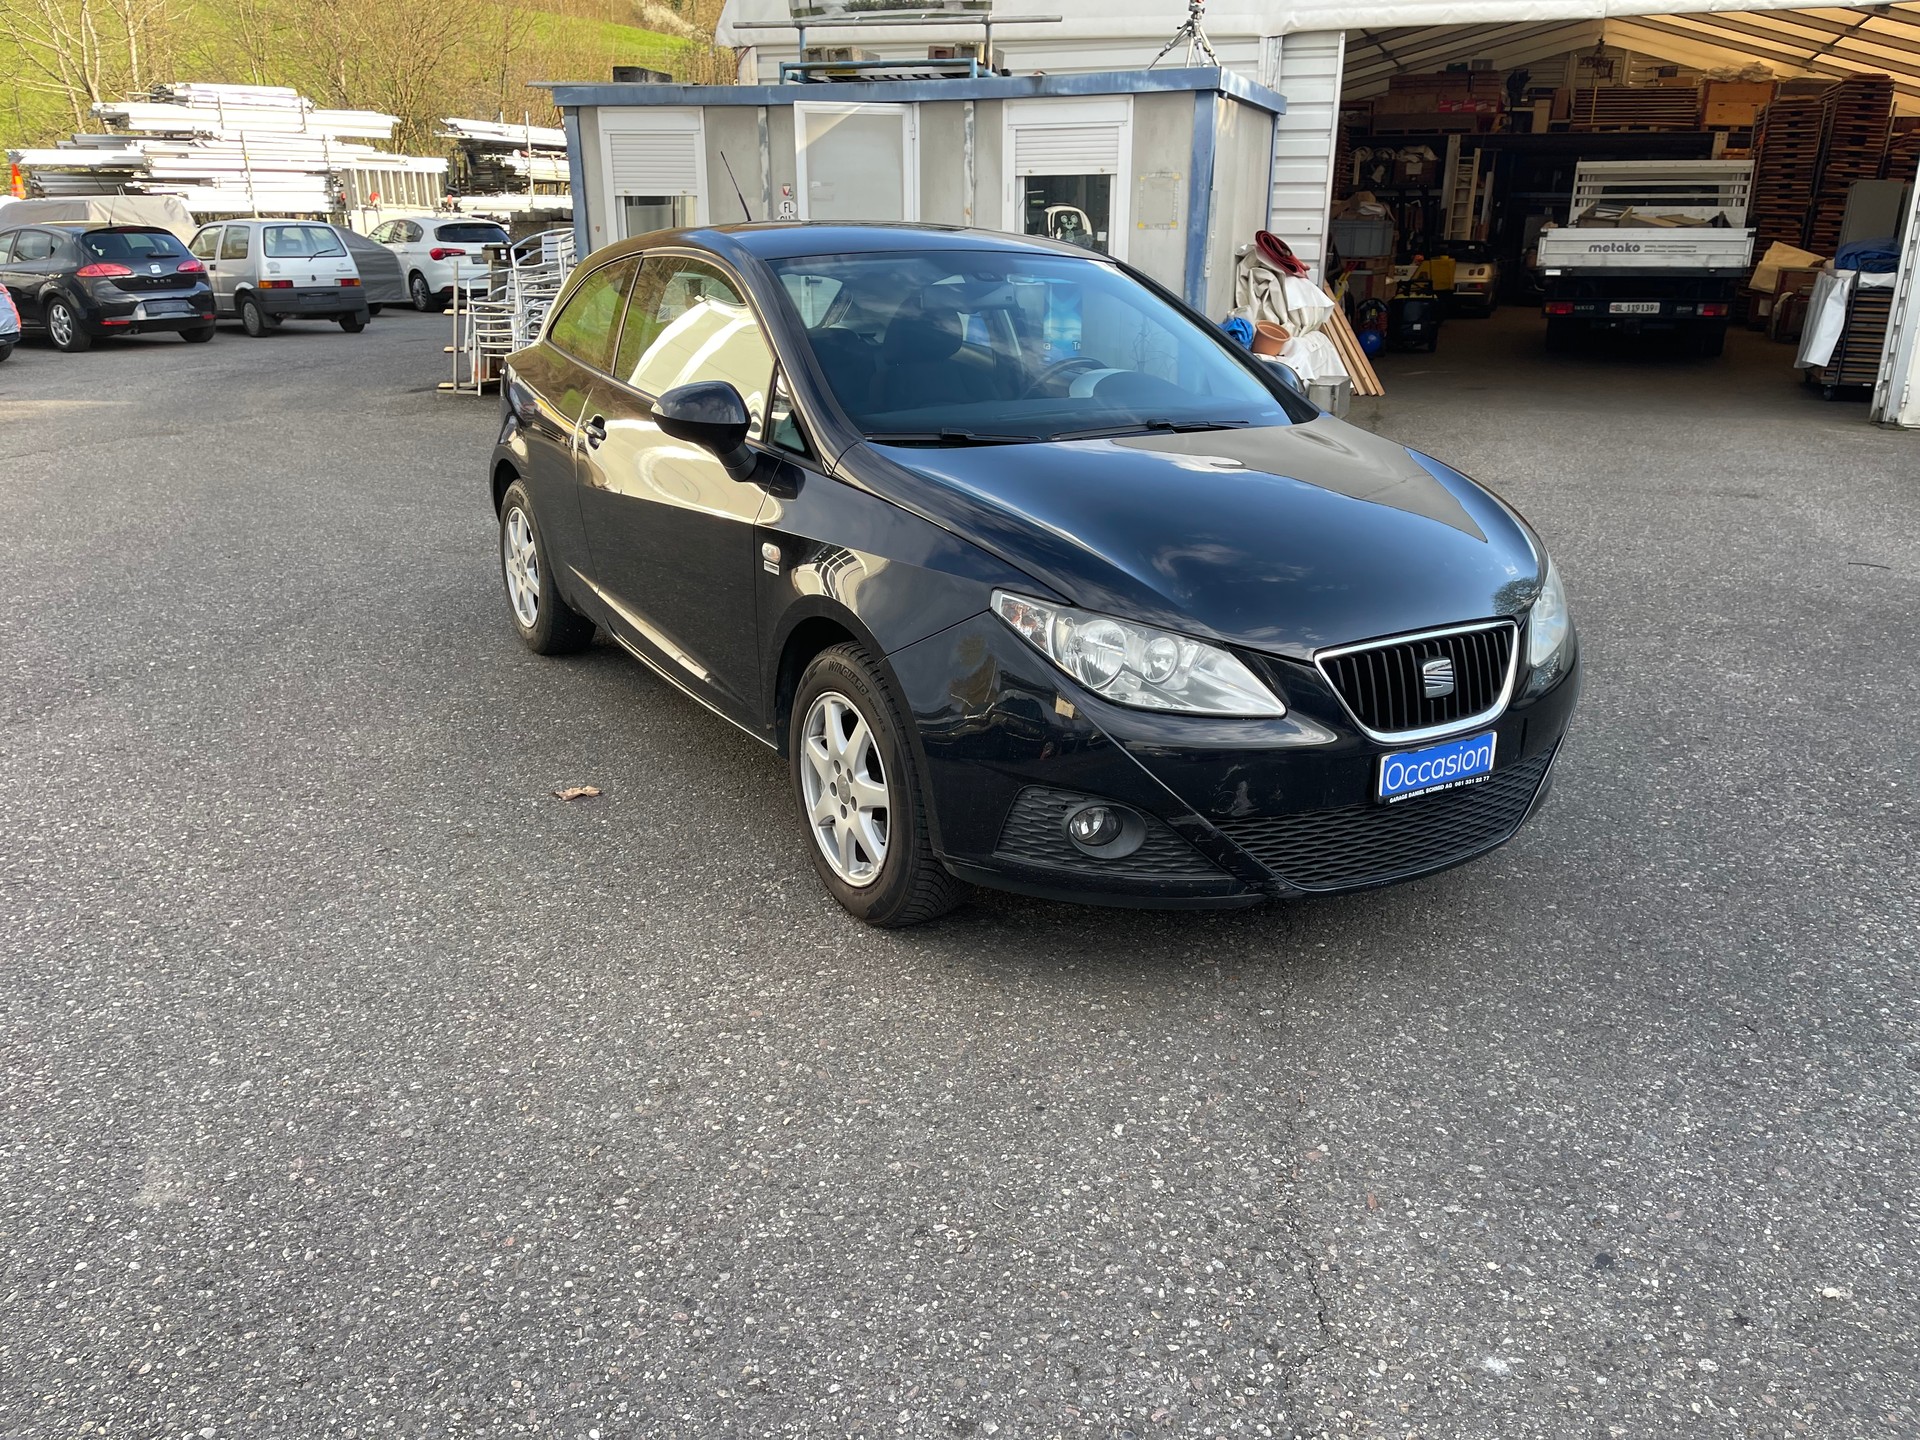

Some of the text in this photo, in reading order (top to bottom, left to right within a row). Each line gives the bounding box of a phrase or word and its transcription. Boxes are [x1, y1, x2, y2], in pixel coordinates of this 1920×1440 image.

[783, 202, 793, 213] FL
[1588, 242, 1641, 253] metako
[828, 660, 869, 696] WINGUARD
[1386, 745, 1490, 790] Occasion
[1389, 793, 1408, 803] GARAGE
[1408, 789, 1425, 798] DANIEL
